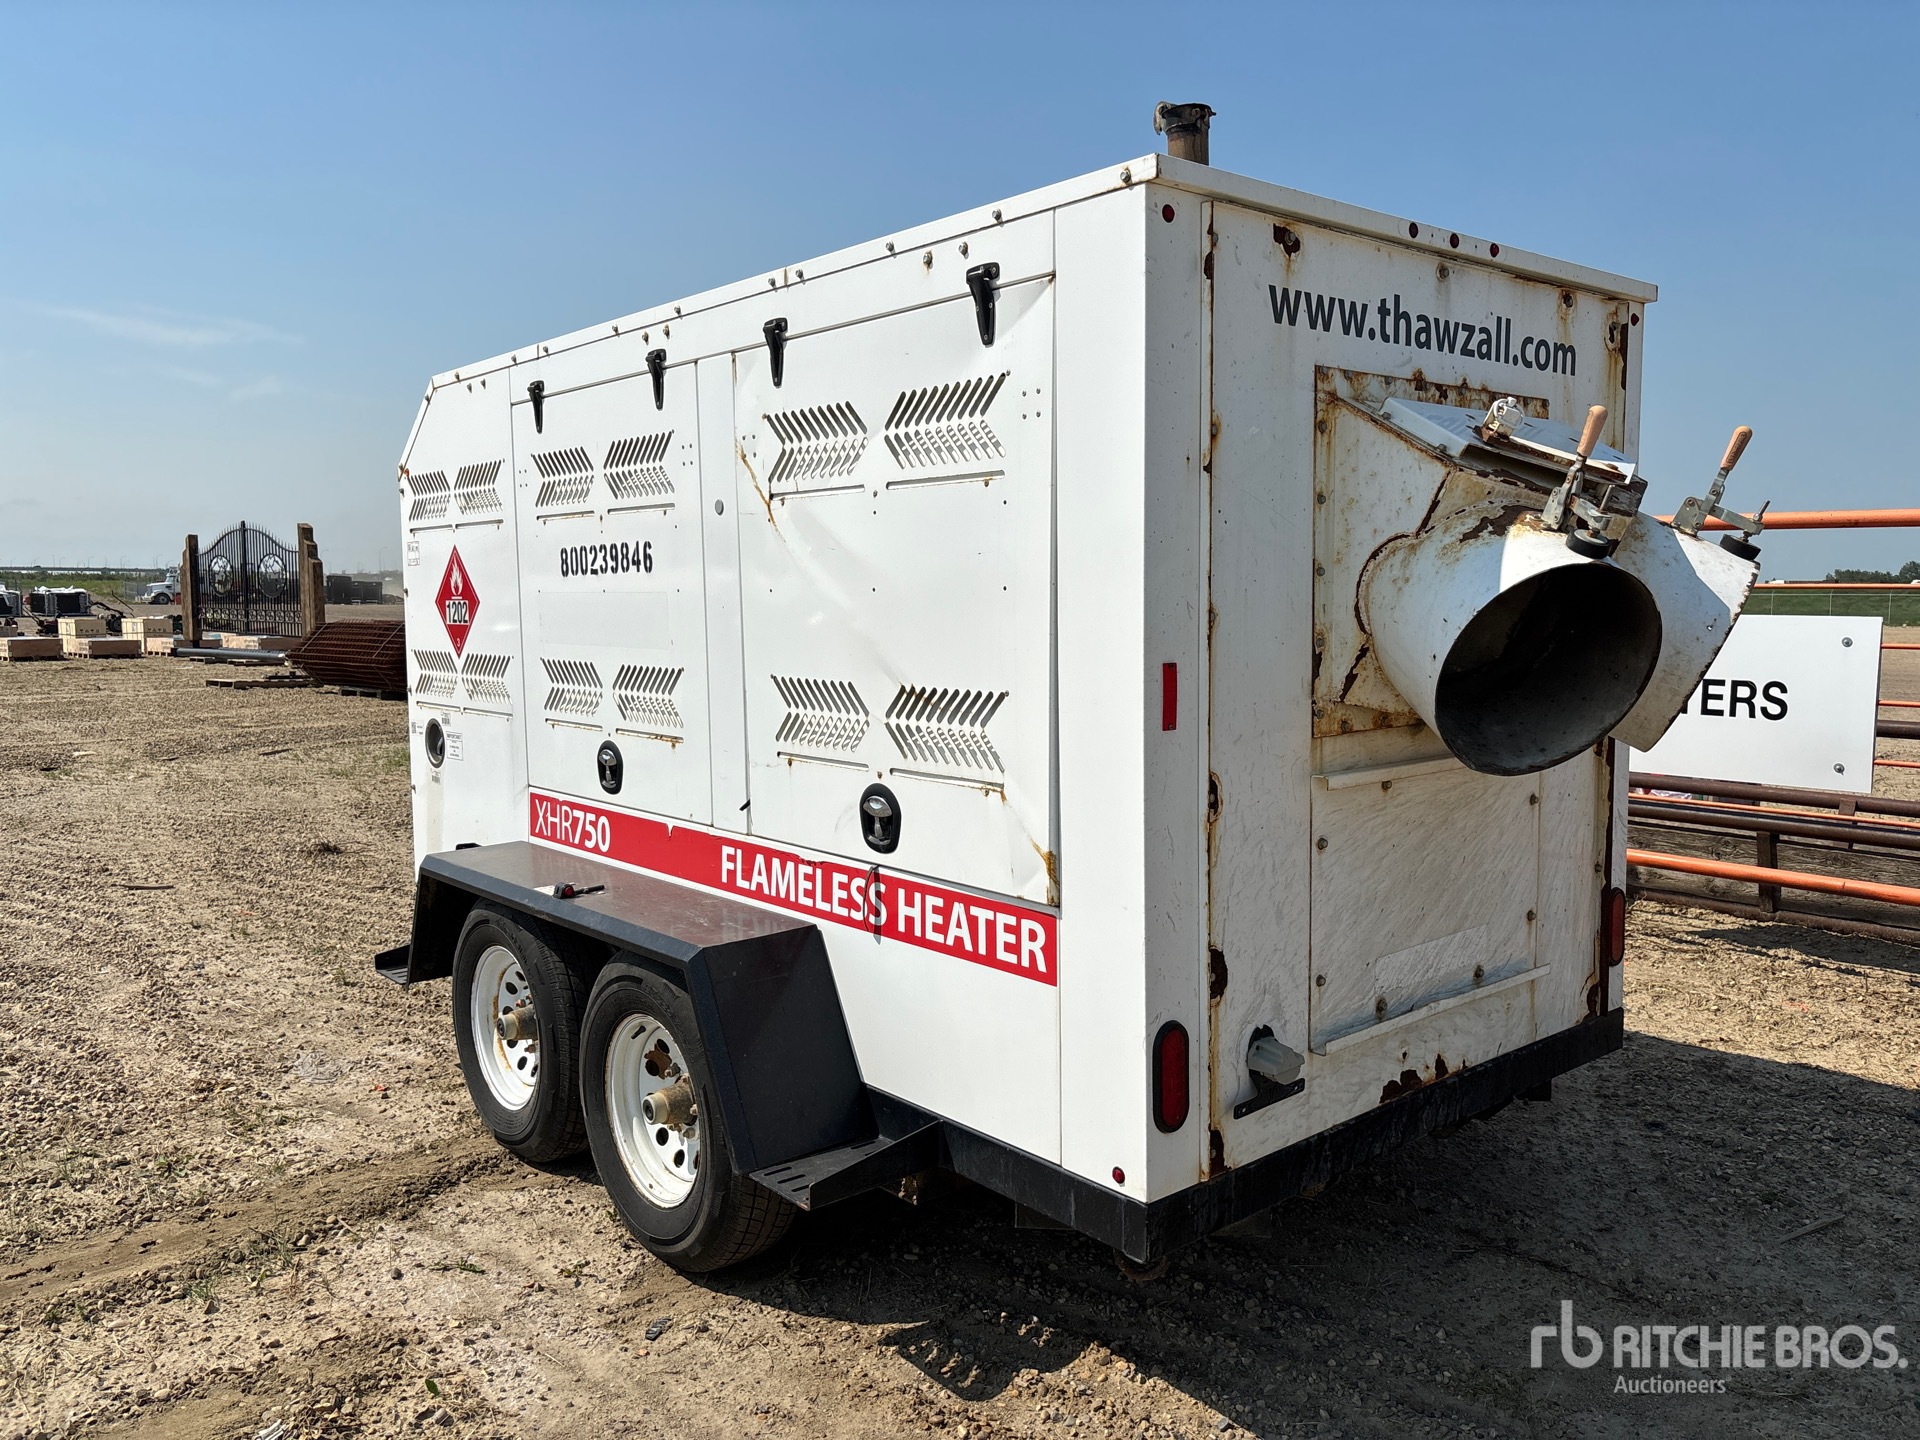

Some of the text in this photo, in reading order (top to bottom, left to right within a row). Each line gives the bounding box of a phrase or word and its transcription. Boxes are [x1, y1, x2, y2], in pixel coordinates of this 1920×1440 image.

[1268, 284, 1576, 376] www.thawzall.com
[560, 540, 653, 578] 800239846
[446, 601, 468, 623] 1202
[1681, 678, 1788, 720] ERS
[534, 799, 610, 853] XHR750
[721, 844, 1047, 973] FLAMELESS HEATER
